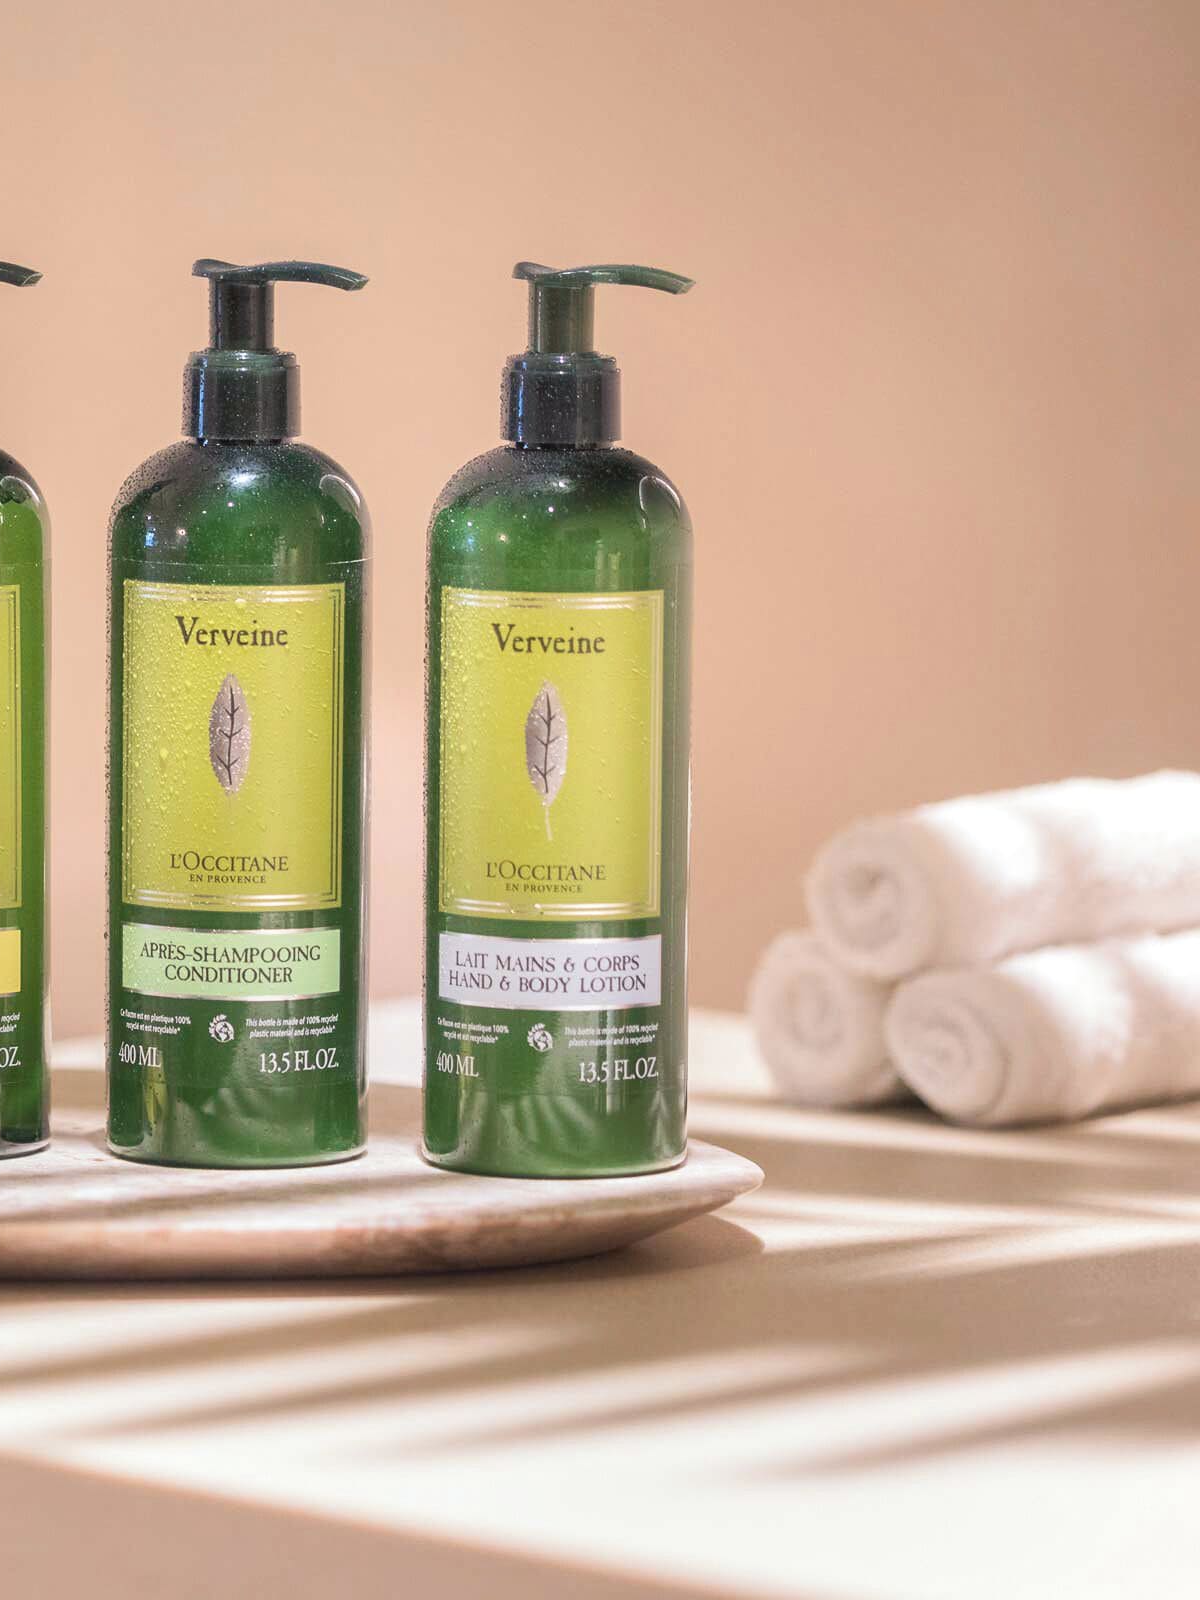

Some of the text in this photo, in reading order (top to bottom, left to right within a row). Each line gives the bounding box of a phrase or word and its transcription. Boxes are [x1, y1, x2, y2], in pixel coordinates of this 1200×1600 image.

[175, 615, 288, 646] Verveine
[491, 623, 605, 654] Verveine
[189, 874, 266, 884] EN PROVENCE
[505, 883, 582, 893] EN PROVENCE
[140, 941, 321, 964] APRÈS-SHAMPOOING
[456, 951, 640, 973] LAIT MAINS & CORPS
[165, 965, 293, 983] CONDITIONER
[449, 971, 646, 993] HAND & BODY LOTION
[151, 1013, 174, 1024] plastique
[175, 1015, 191, 1025] 100%
[246, 1018, 258, 1027] This
[259, 1018, 276, 1026] bottle
[277, 1018, 282, 1026] is
[282, 1017, 299, 1026] made
[299, 1016, 306, 1025] of
[306, 1015, 320, 1024] 100%
[626, 1025, 640, 1033] 100%
[249, 1029, 269, 1039] plastic
[269, 1028, 294, 1037] material
[294, 1027, 305, 1036] and
[492, 1025, 509, 1034] 100%
[613, 1037, 624, 1046] and
[118, 1041, 161, 1068] 400 ML
[260, 1052, 290, 1074] 13.5
[436, 1050, 479, 1077] 400 ML
[579, 1061, 610, 1083] 13.5
